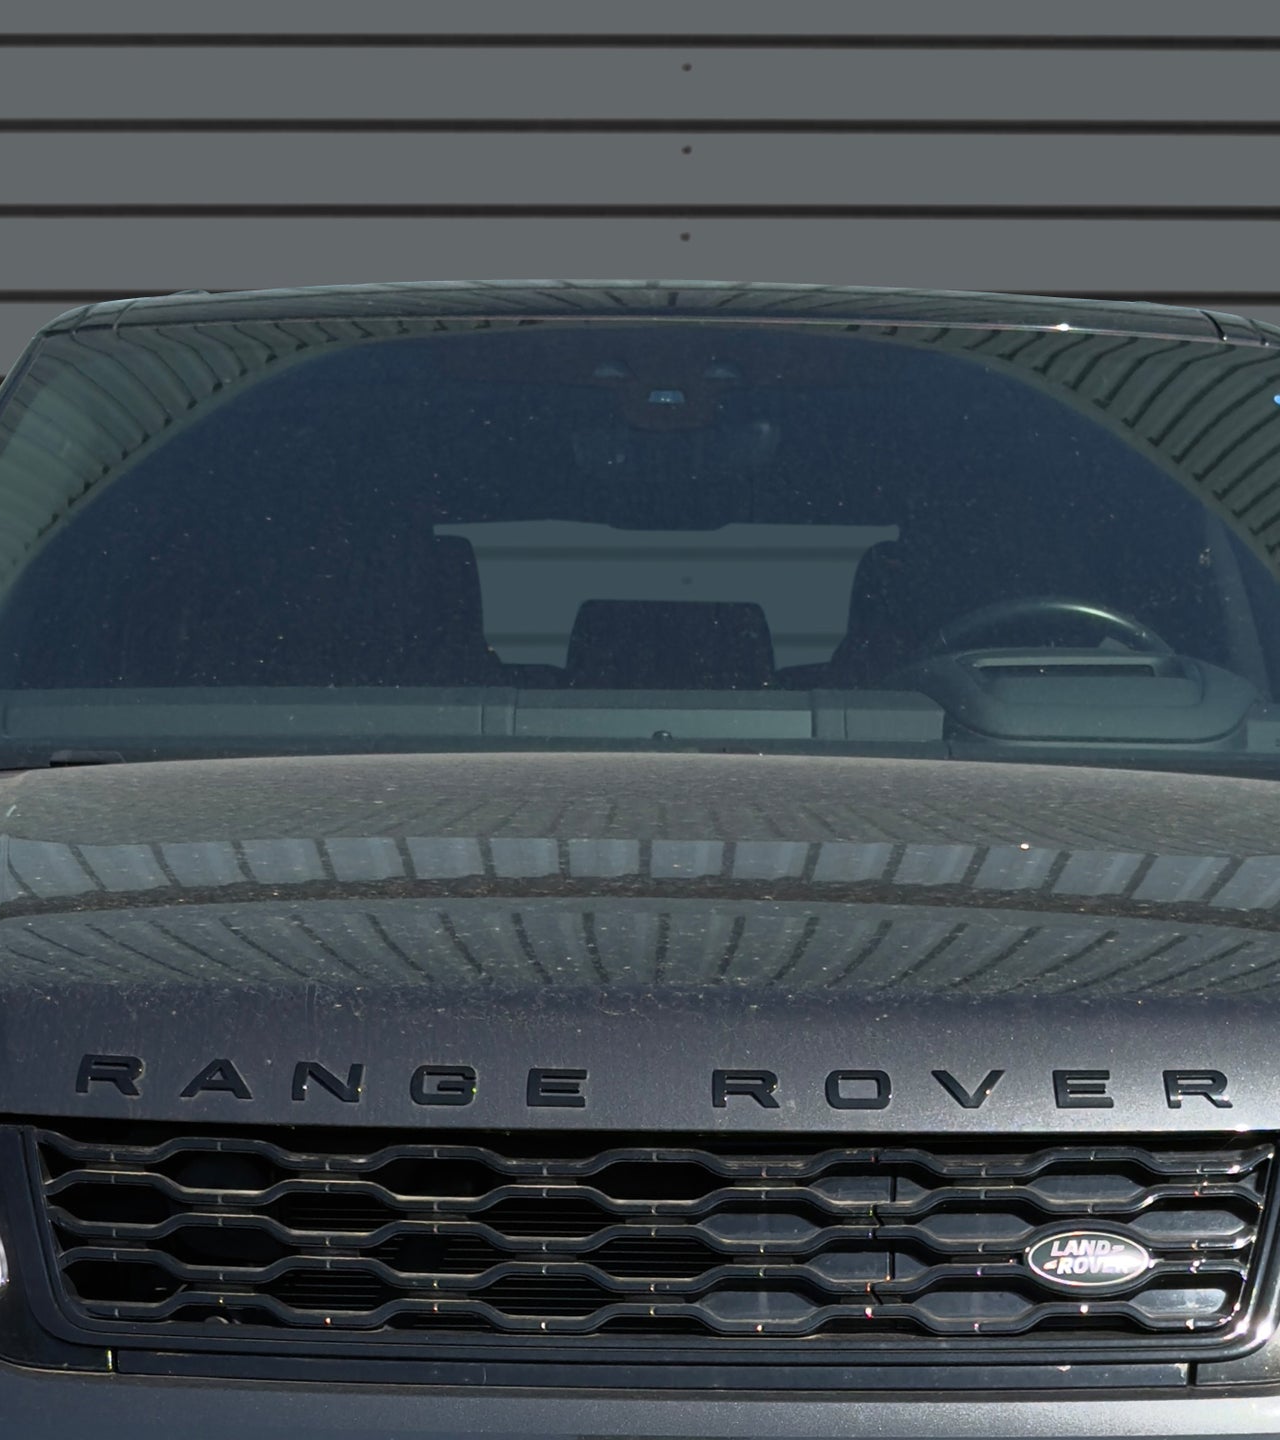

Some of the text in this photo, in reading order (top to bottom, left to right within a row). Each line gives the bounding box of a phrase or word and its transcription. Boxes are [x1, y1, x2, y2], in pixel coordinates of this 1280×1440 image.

[75, 1053, 1234, 1109] RANGE ROVER
[1051, 1239, 1111, 1256] LAND
